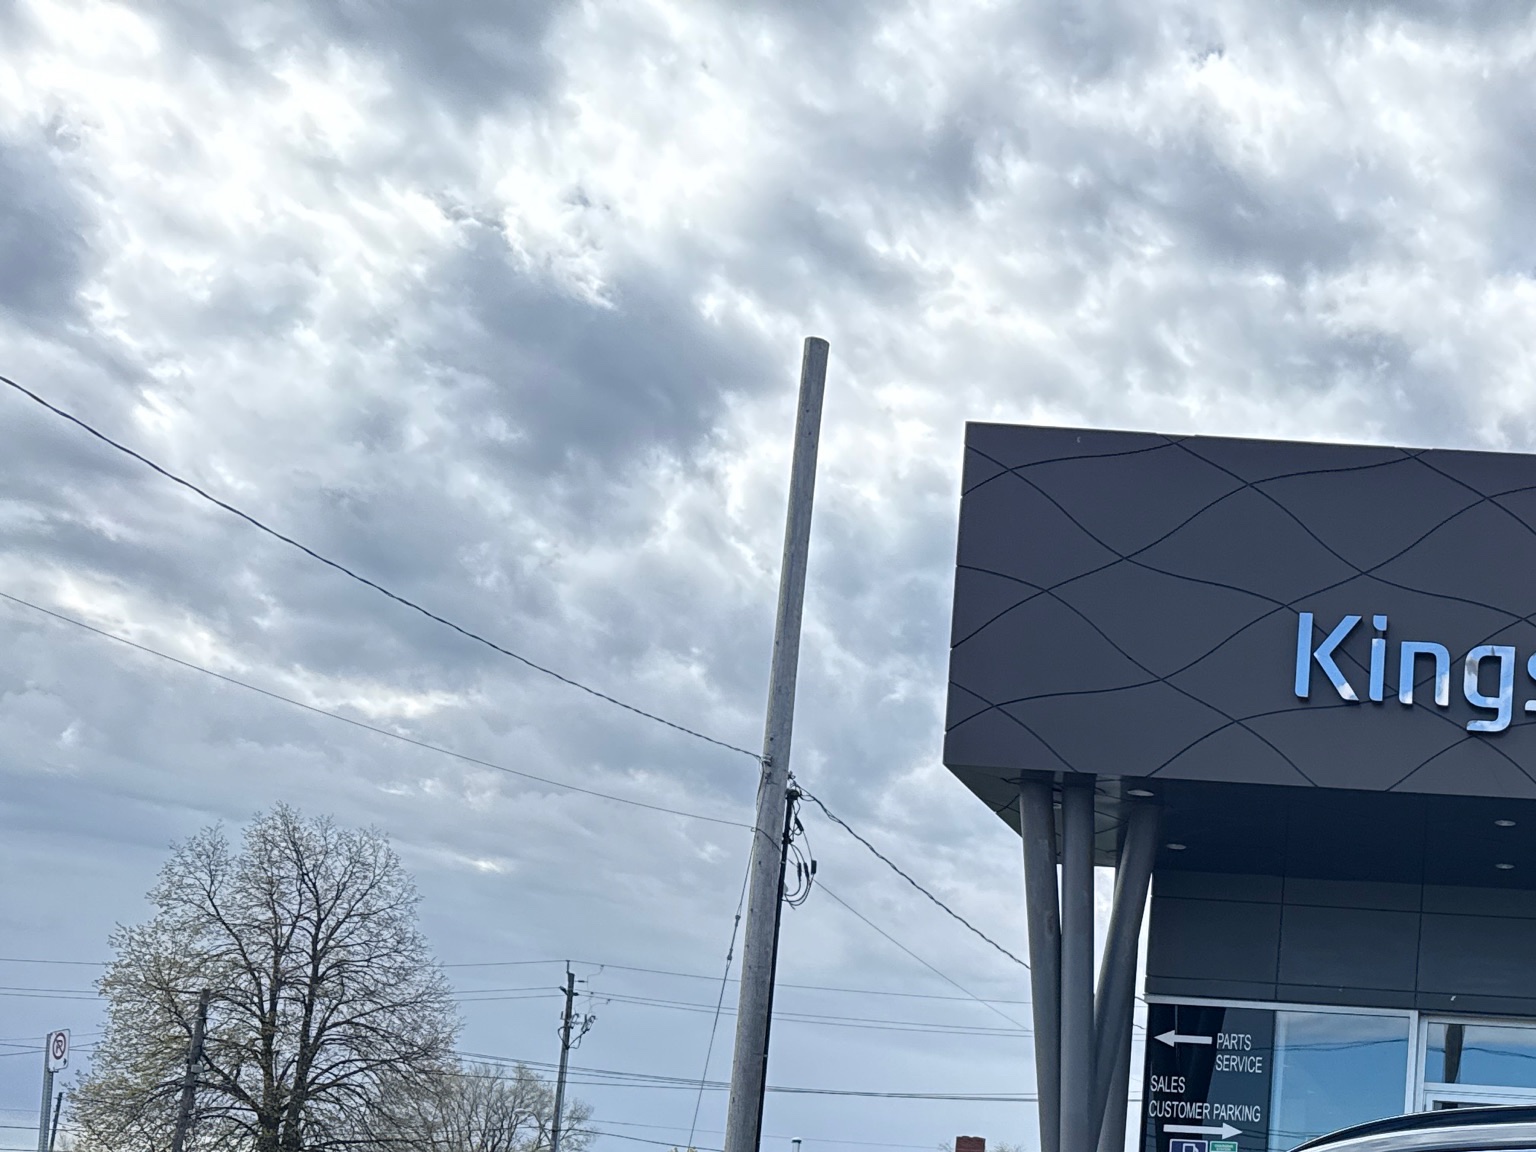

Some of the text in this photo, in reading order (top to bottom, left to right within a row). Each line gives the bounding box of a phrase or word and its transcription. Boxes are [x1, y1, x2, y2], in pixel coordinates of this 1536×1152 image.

[1216, 1032, 1252, 1051] PARTS
[1215, 1054, 1263, 1073] SERVICE
[1150, 1075, 1186, 1093] SALES
[1148, 1100, 1261, 1122] CUSTOMER PARKING
